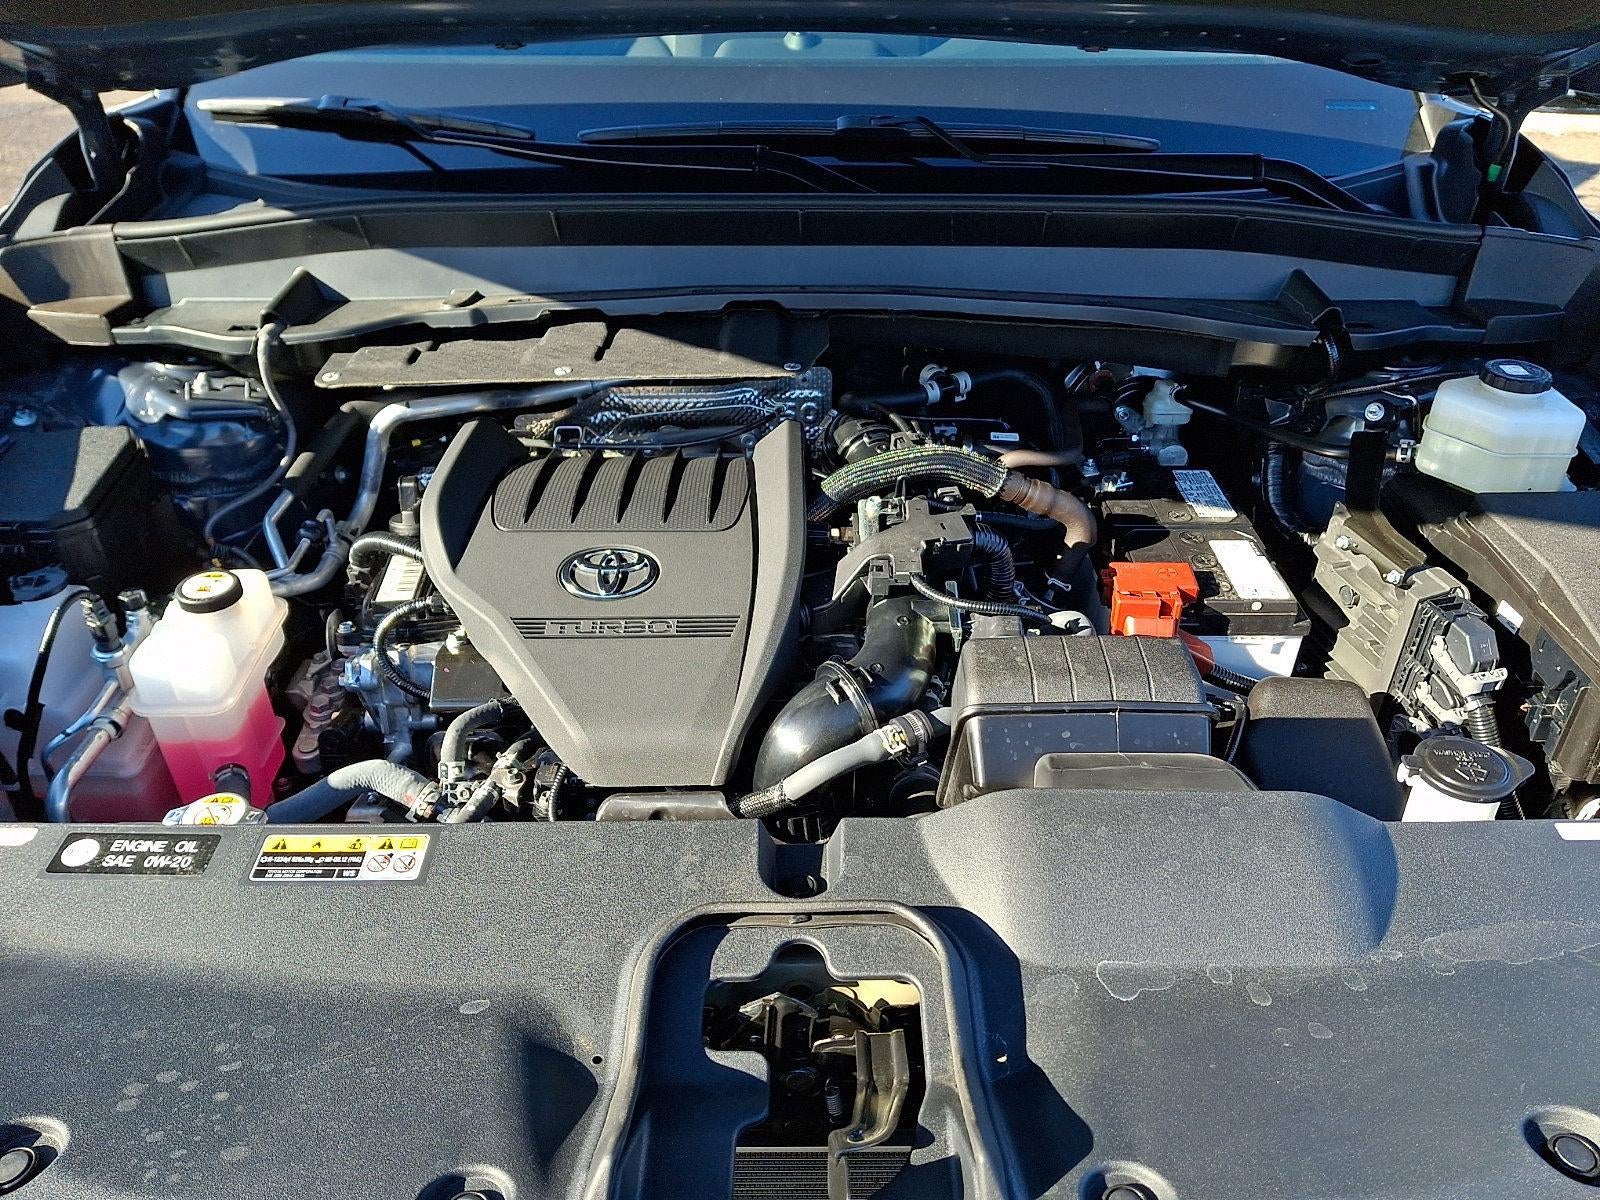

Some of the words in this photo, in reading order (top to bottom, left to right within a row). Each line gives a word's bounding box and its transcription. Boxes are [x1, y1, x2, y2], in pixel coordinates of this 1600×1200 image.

[549, 618, 674, 635] TURBO
[109, 839, 169, 853] ENGINE
[174, 840, 199, 853] OIL
[101, 854, 137, 868] SAE
[143, 855, 193, 869] 0W-20
